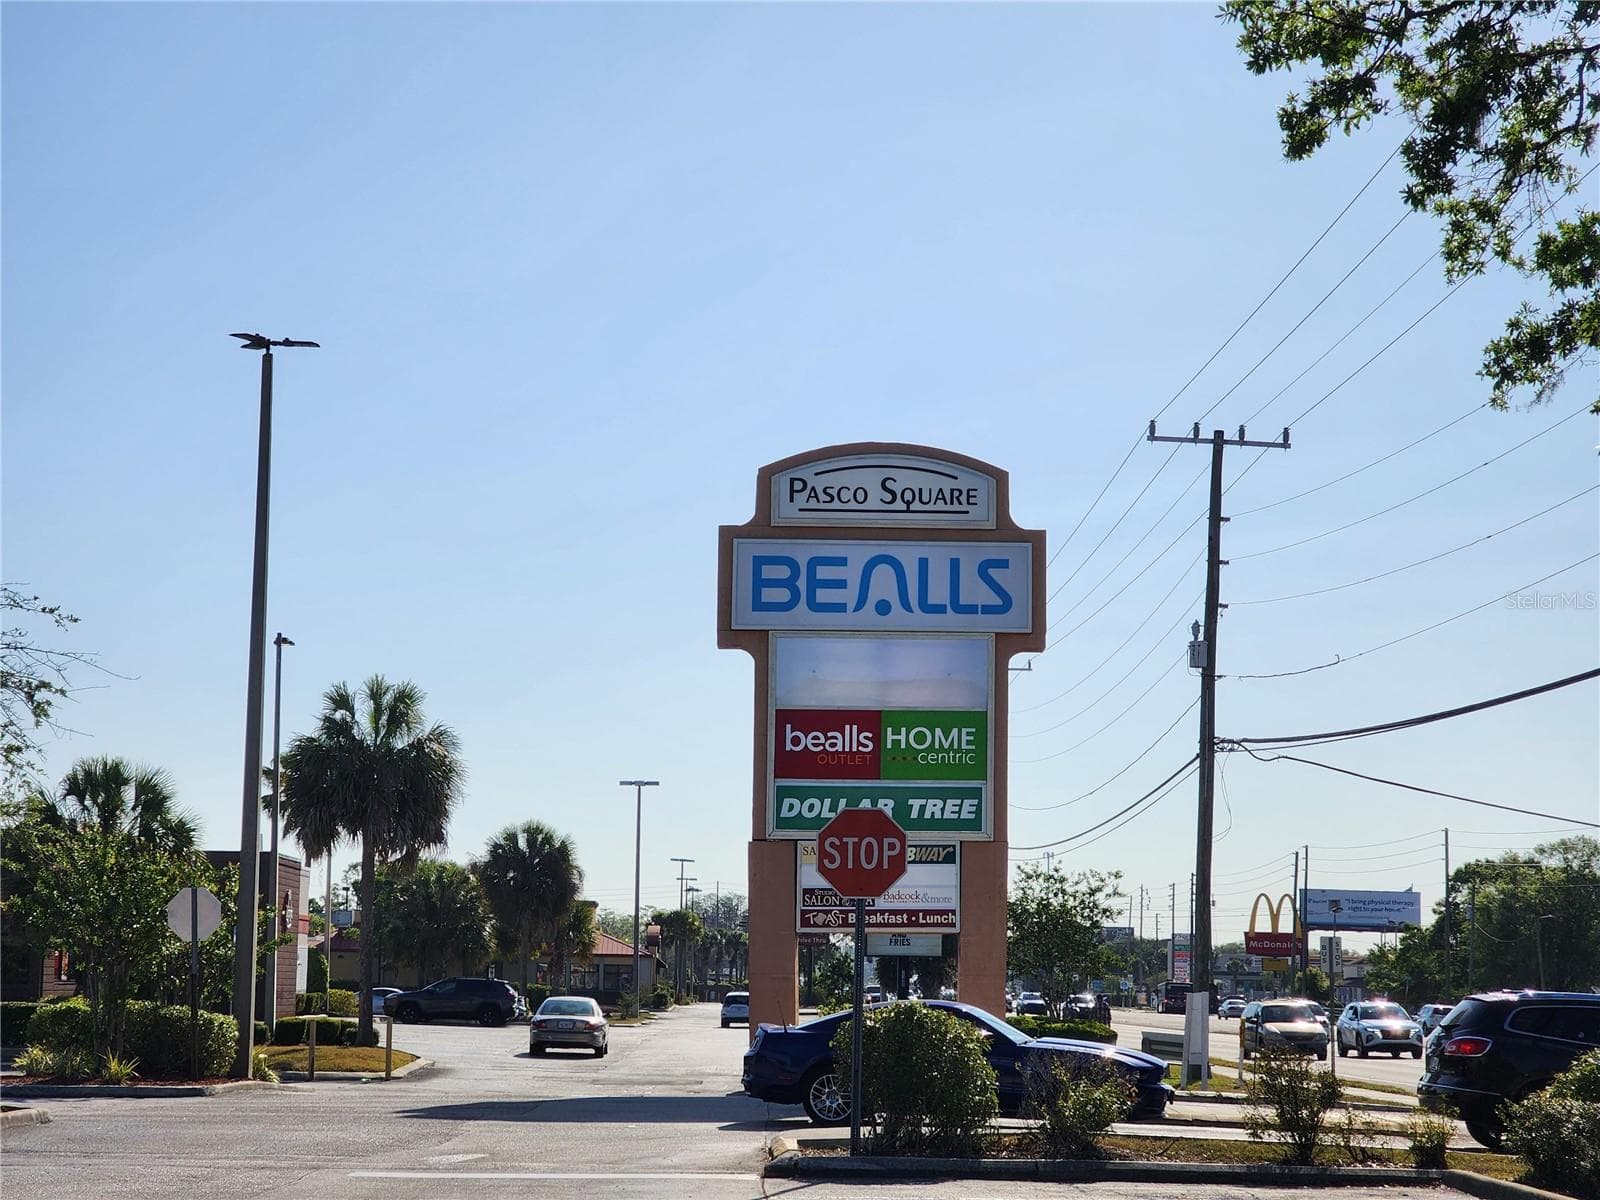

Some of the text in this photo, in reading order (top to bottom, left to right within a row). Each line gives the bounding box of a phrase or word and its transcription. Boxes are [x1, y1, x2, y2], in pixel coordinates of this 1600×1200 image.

[751, 553, 1013, 617] BEALLS
[785, 723, 874, 753] bealls
[886, 726, 976, 750] HOME
[817, 754, 873, 765] OUTLET
[917, 750, 976, 764] centric
[907, 798, 979, 819] TREE
[823, 836, 901, 870] STOP
[804, 894, 840, 906] SALON
[883, 890, 921, 900] Badcock
[848, 912, 908, 924] Beakfast
[918, 912, 956, 924] Lunch
[889, 938, 911, 947] FRIES
[1249, 940, 1303, 949] McDonal's
